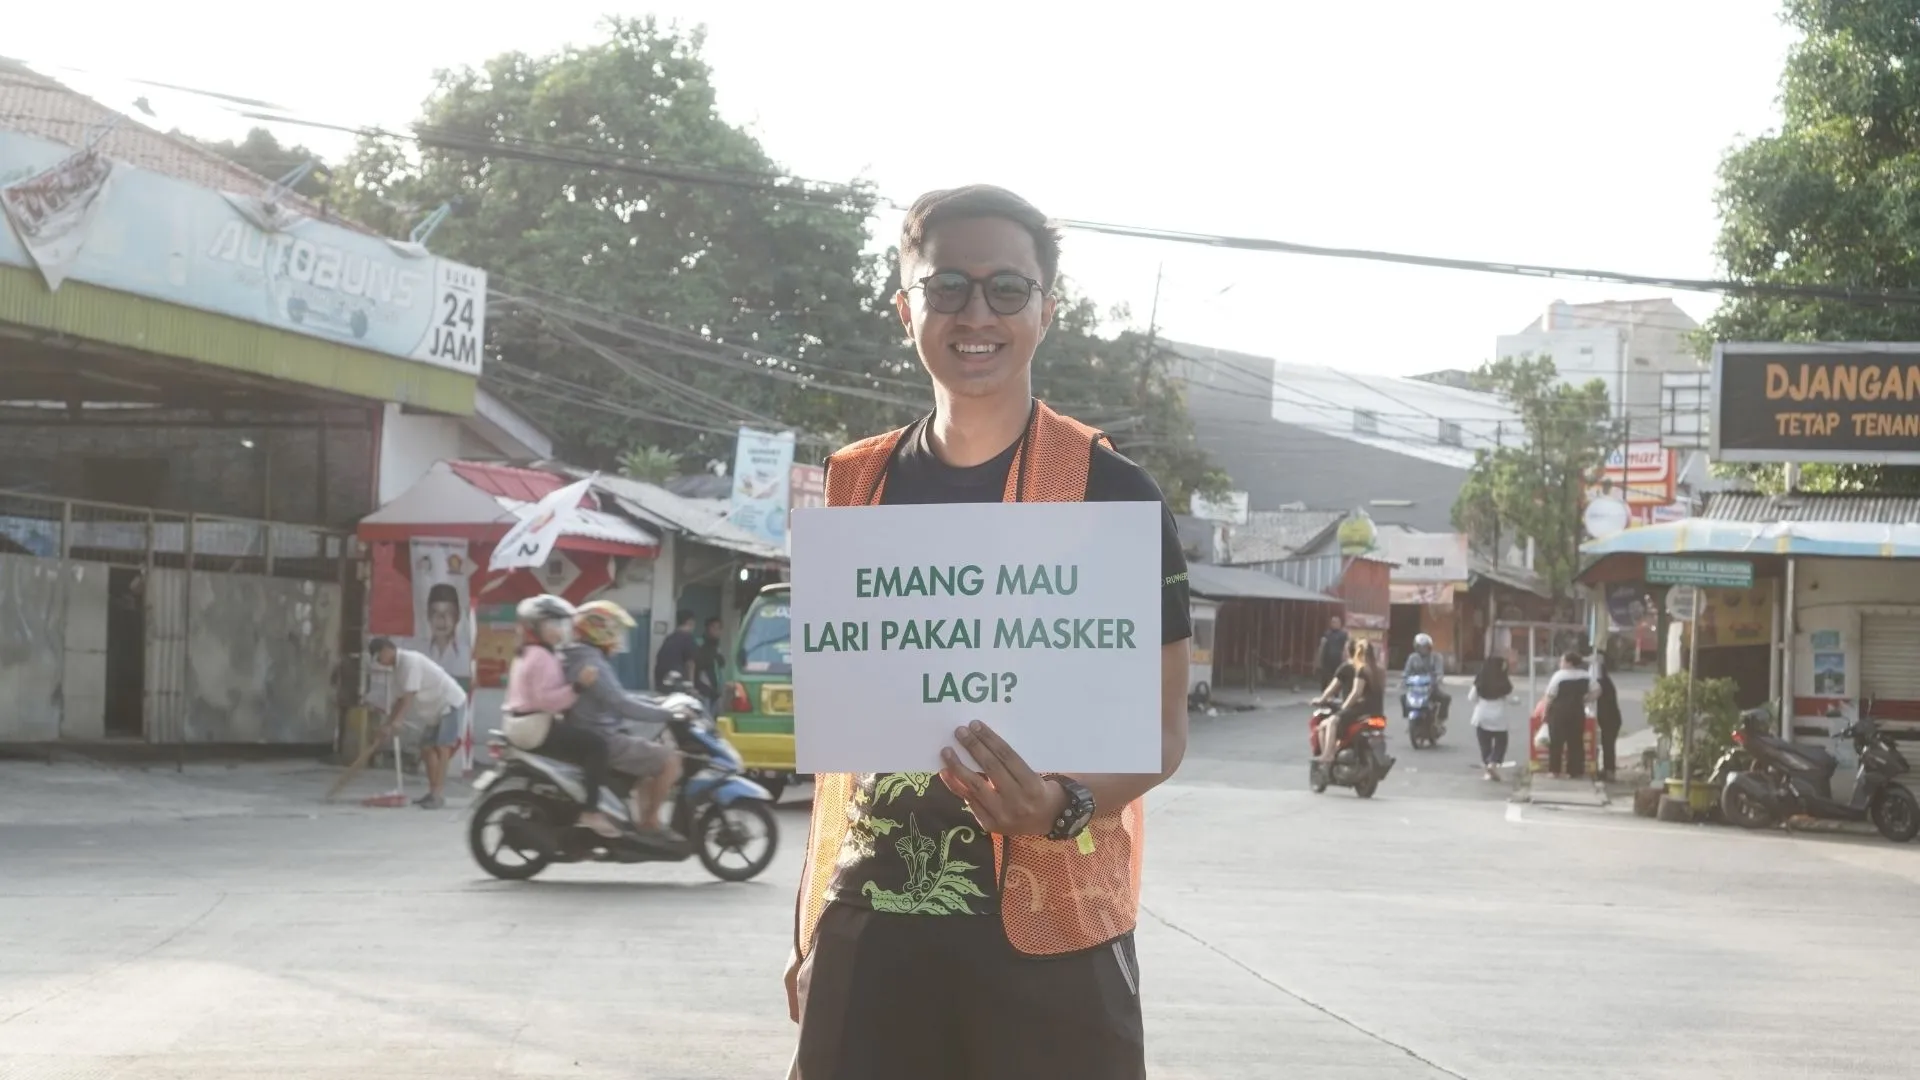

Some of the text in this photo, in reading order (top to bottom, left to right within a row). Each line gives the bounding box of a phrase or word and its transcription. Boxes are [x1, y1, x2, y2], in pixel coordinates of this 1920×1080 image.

[443, 292, 474, 332] 24
[429, 327, 476, 366] JAM
[1765, 363, 1920, 401] DJANGAN
[1775, 412, 1920, 437] TETAP TENAN
[856, 563, 1078, 598] EMANG MAU
[803, 617, 1137, 653] LARI PAKAI MASKER
[922, 671, 1018, 704] LAGI?
